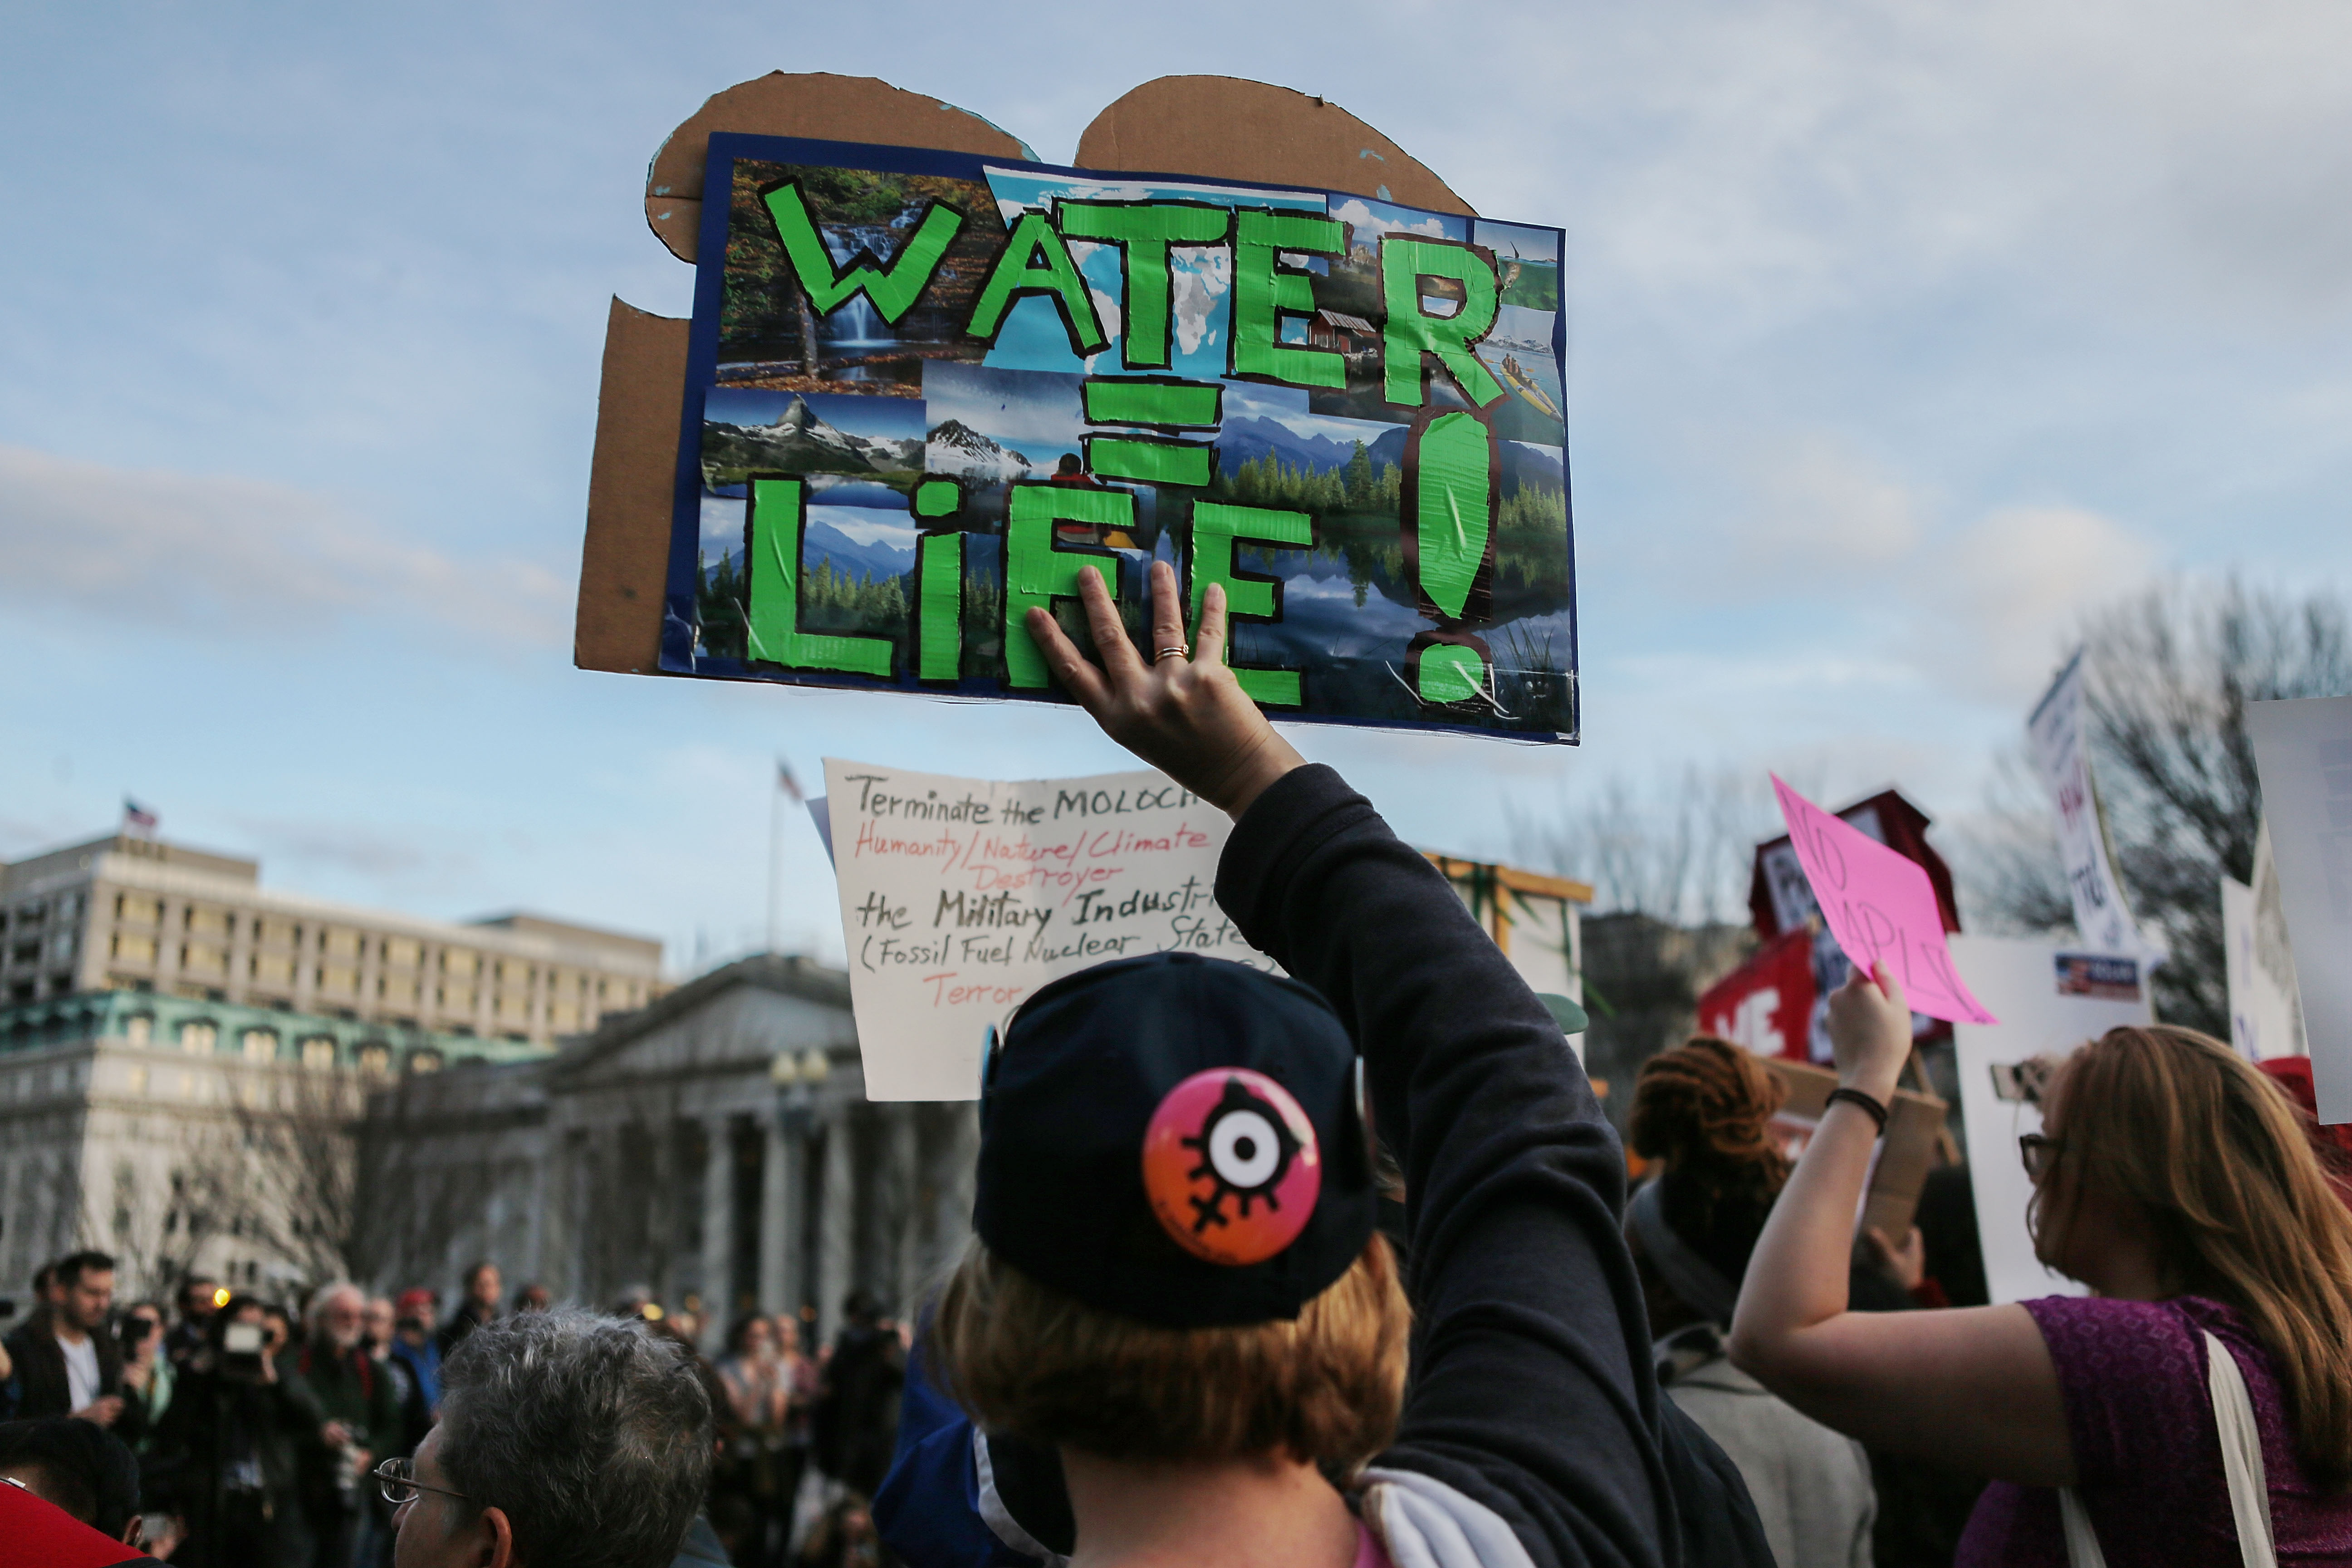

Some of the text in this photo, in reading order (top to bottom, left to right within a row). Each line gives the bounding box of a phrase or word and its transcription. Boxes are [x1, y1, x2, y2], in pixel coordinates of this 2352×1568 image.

[760, 176, 1507, 411] WATER
[845, 775, 993, 824] Terminate
[1001, 799, 1044, 825] the
[968, 864, 1123, 906] Destroyer
[857, 891, 912, 930] the
[934, 889, 1052, 939] Military
[961, 936, 1014, 965] Fuel
[1024, 933, 1140, 963] Nuclear
[923, 973, 1023, 1007] Terror
